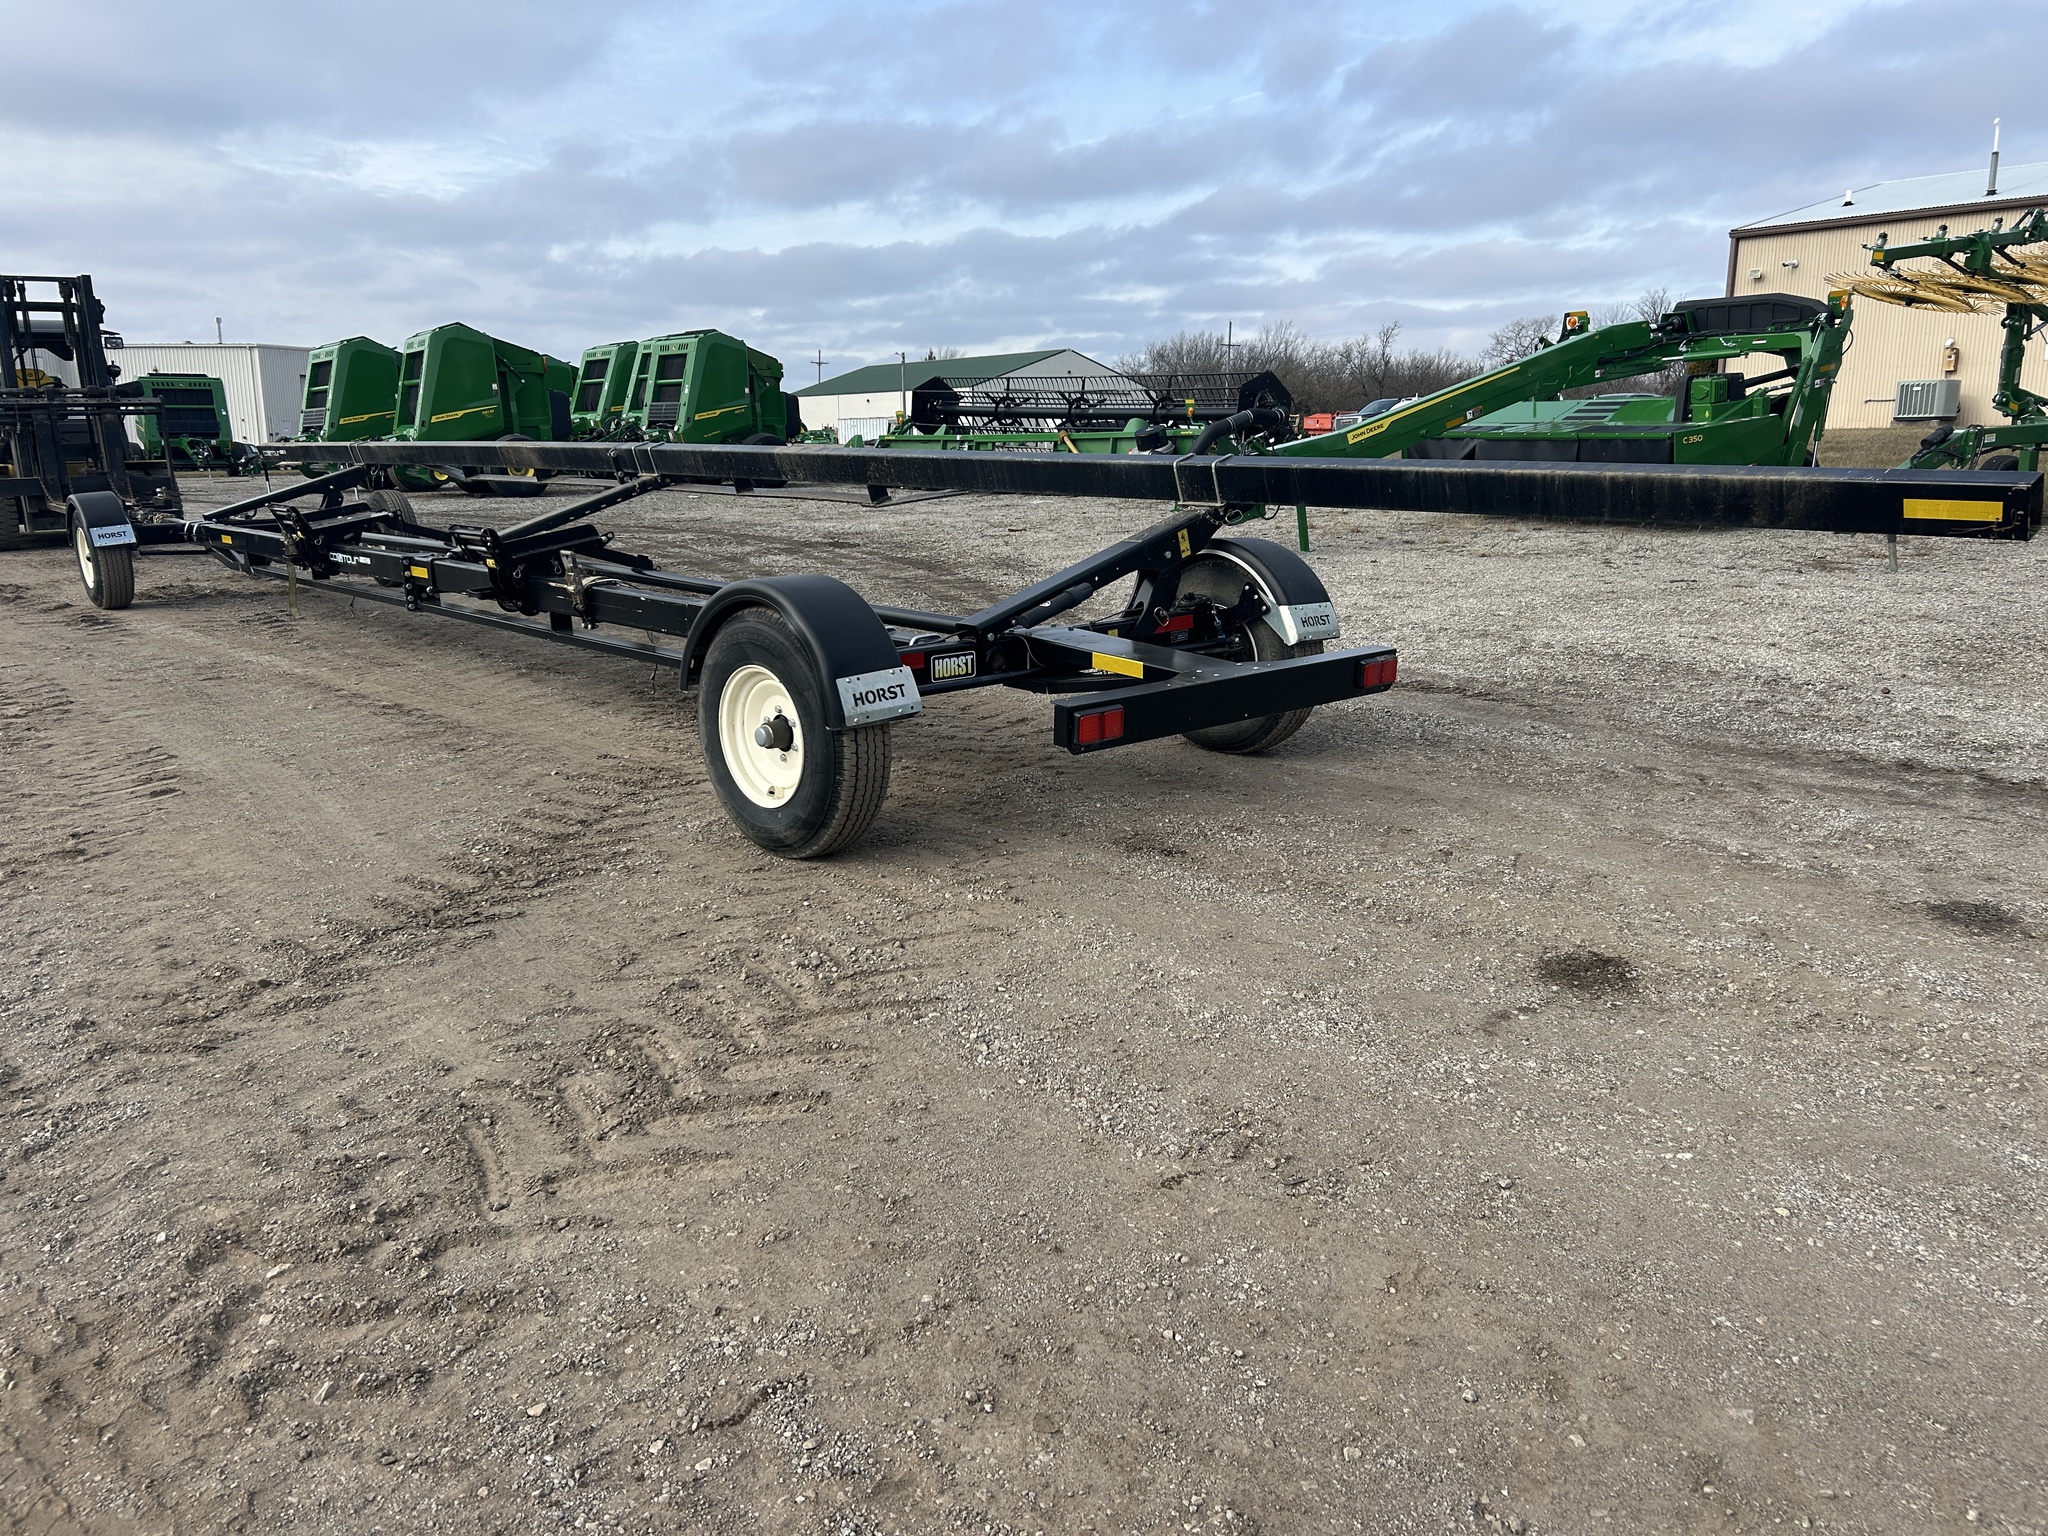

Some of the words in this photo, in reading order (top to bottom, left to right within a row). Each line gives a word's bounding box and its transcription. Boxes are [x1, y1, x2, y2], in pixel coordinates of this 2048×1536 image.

[1351, 431, 1366, 440] JOHN
[1365, 423, 1385, 434] DEERE
[97, 531, 128, 540] HORST
[1300, 614, 1331, 628] HORST
[934, 655, 974, 679] HORST
[852, 683, 906, 708] HORST
